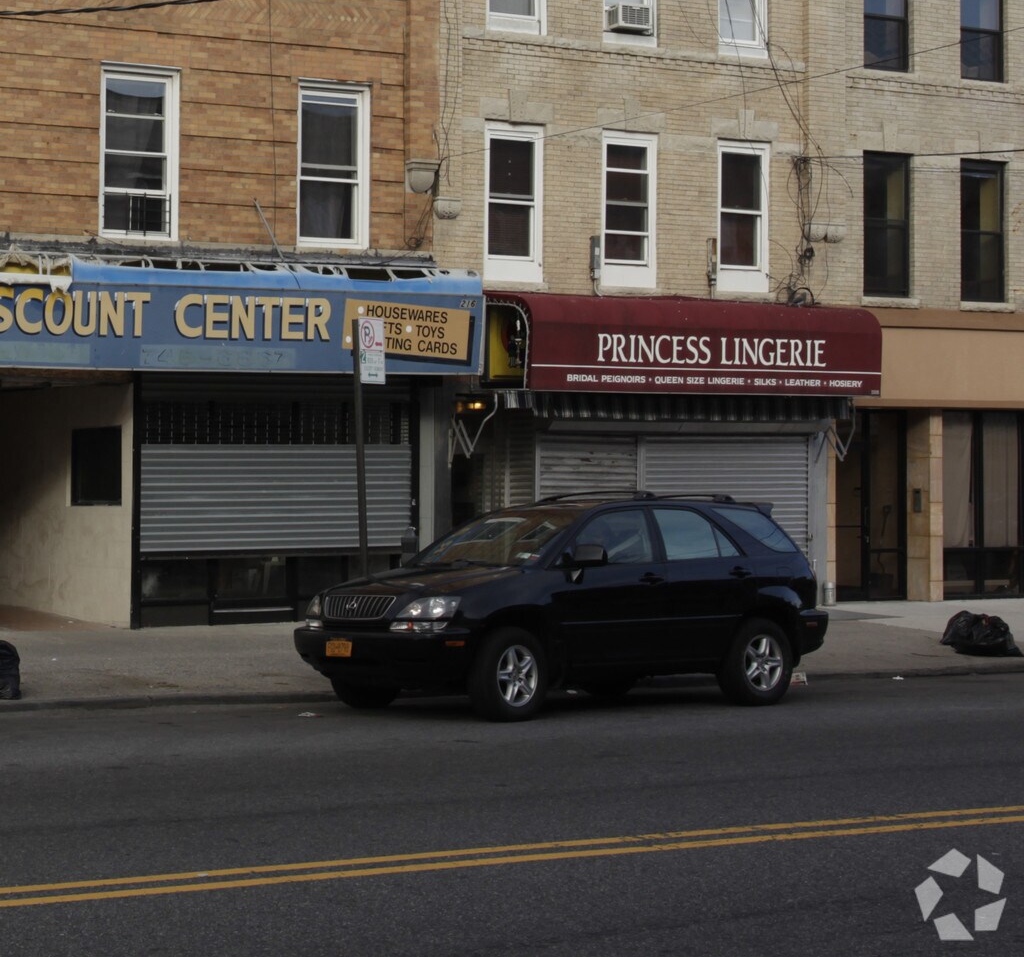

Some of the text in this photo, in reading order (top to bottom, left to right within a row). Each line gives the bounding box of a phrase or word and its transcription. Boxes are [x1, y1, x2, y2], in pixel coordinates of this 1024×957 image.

[460, 300, 476, 308] 216
[175, 293, 331, 342] CENTER
[366, 305, 448, 324] HOUSEWARES
[415, 325, 445, 339] TOYS
[385, 336, 458, 355] TING CARDS
[597, 333, 826, 367] PRINCESS LINGERIE
[567, 374, 863, 388] BRIDAL PEIGNOIRS QUEEN SIZE LINGERIE SILKS LEATHER HOSIERY
